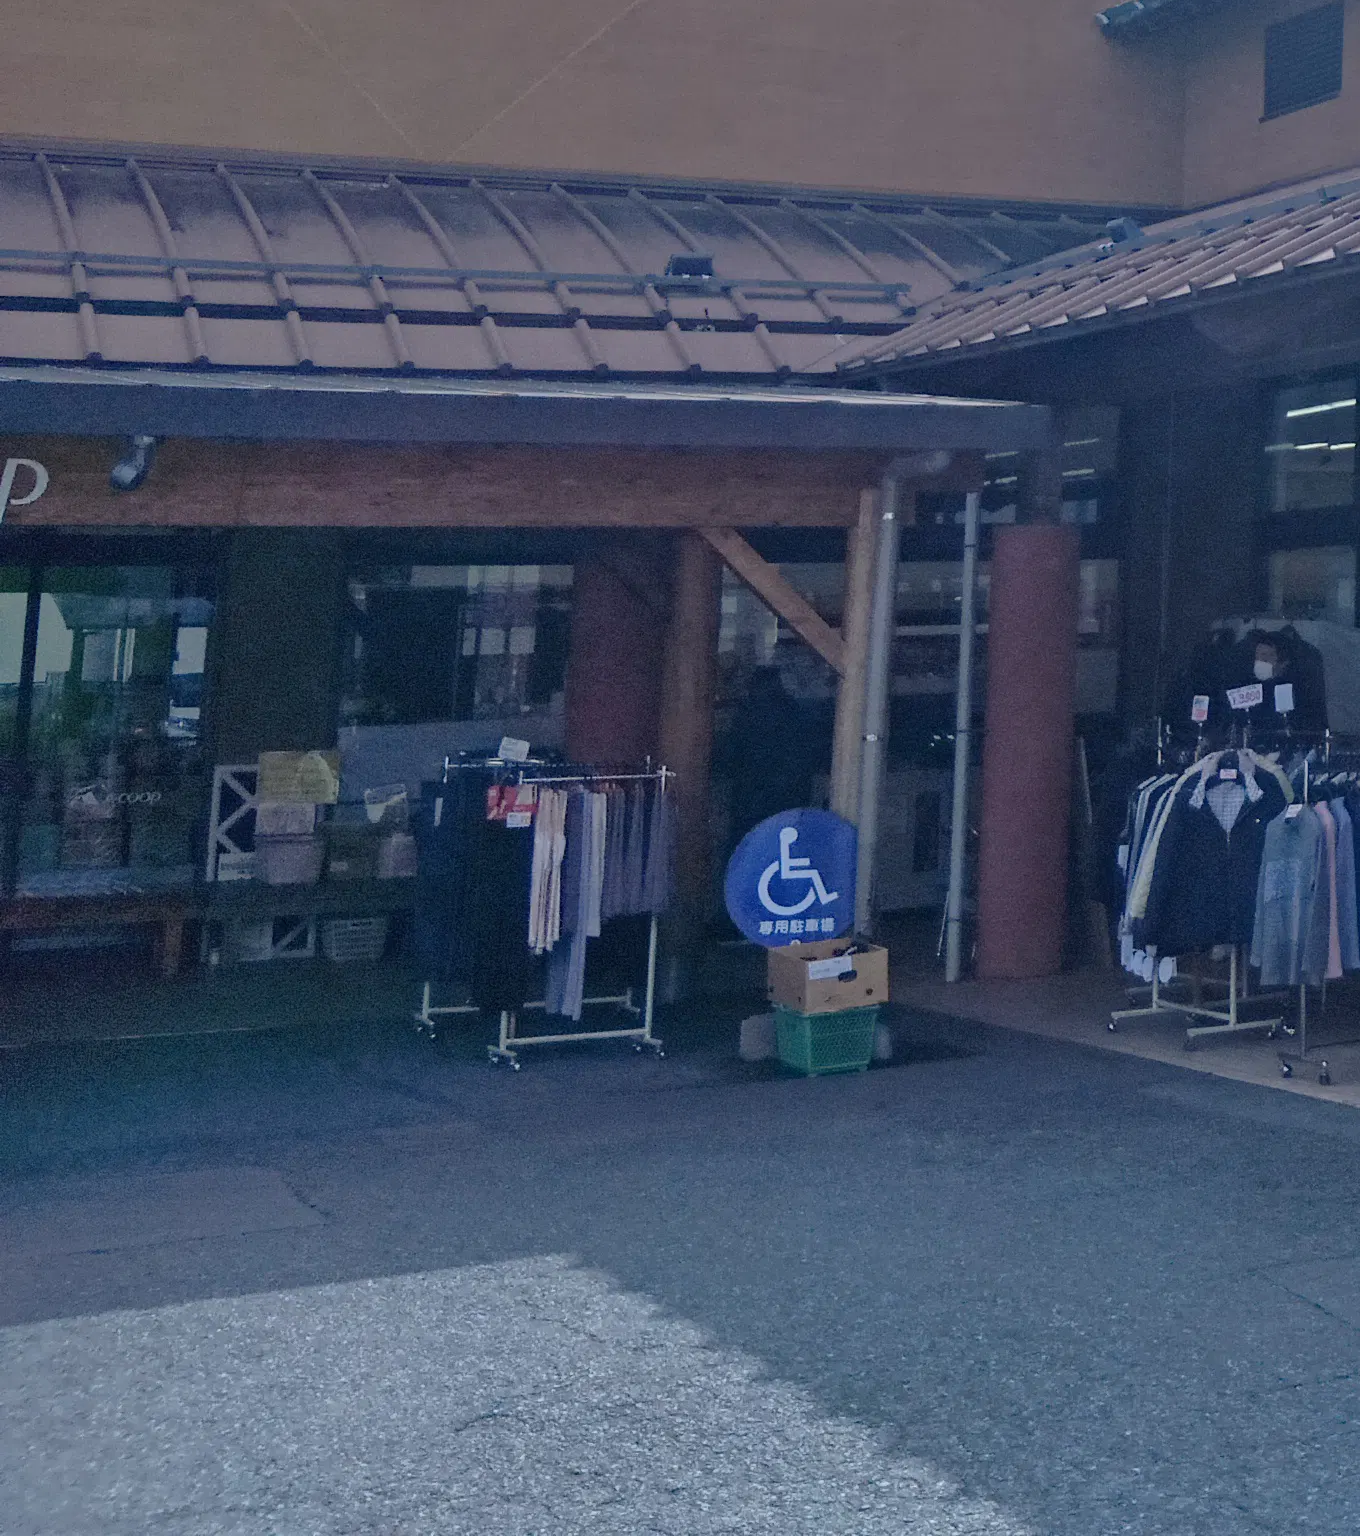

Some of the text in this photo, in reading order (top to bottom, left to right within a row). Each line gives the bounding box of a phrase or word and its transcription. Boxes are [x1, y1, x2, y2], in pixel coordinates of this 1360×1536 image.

[759, 917, 835, 935] 専用駐車場
